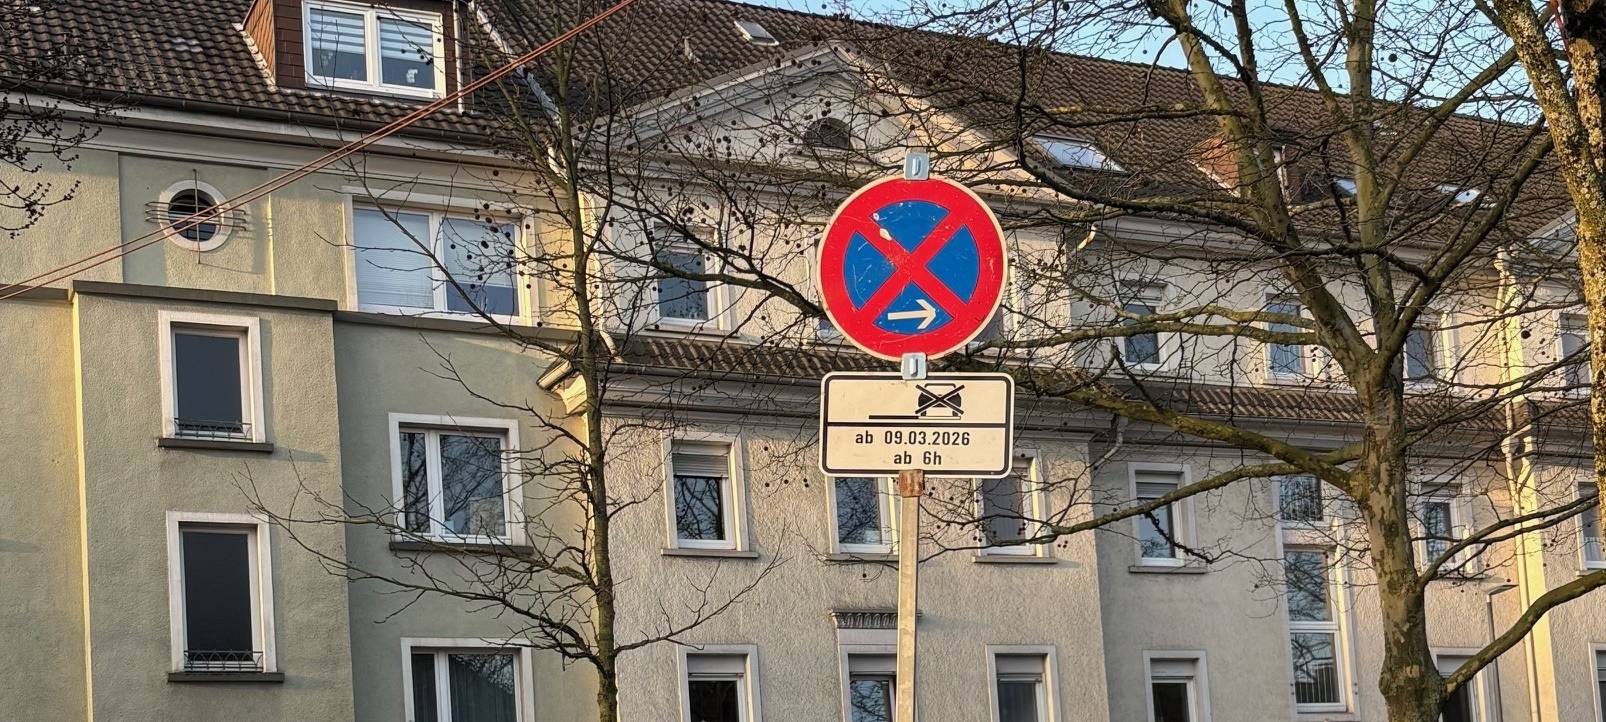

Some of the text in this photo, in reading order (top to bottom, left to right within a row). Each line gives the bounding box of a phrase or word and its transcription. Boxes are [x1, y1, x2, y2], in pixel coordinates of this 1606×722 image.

[855, 430, 970, 446] ab 09.03.2026
[893, 450, 942, 465] ab 6h
